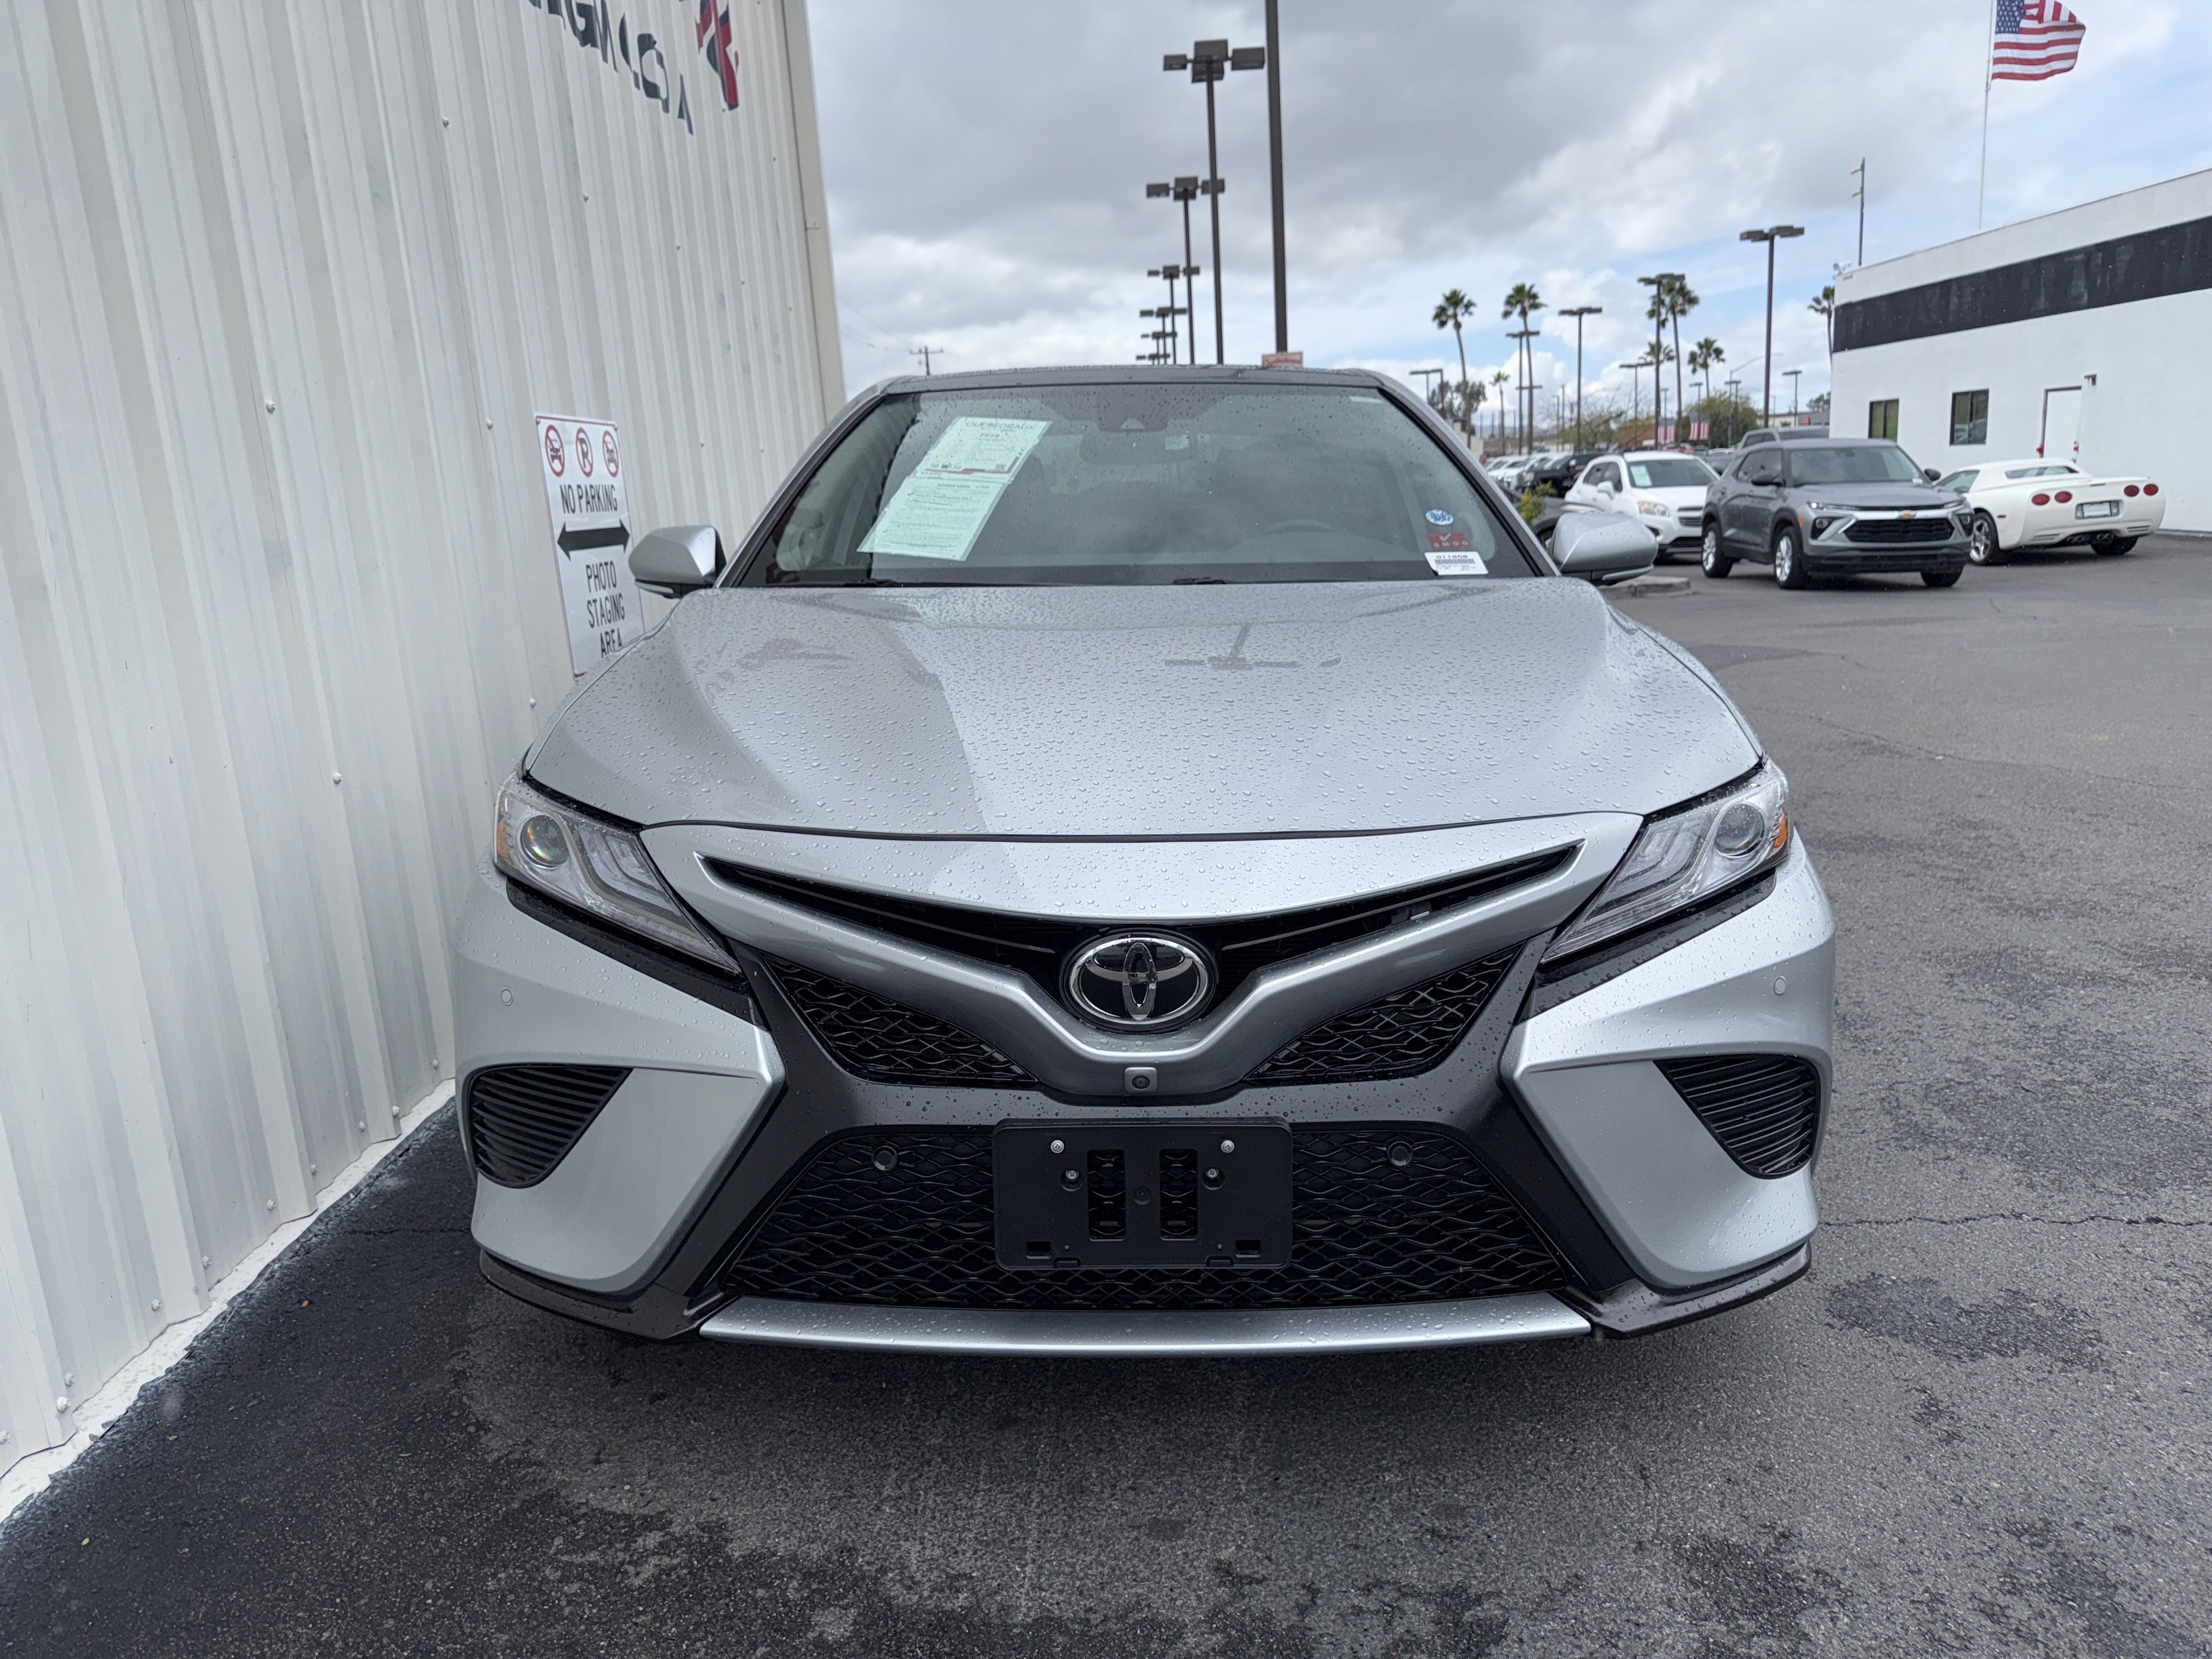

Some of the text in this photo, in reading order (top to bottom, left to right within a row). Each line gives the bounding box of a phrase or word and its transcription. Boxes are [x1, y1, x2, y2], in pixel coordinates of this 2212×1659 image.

[560, 484, 618, 514] NO PARKING
[586, 561, 617, 593] PHOTO
[588, 594, 625, 628] STAGING
